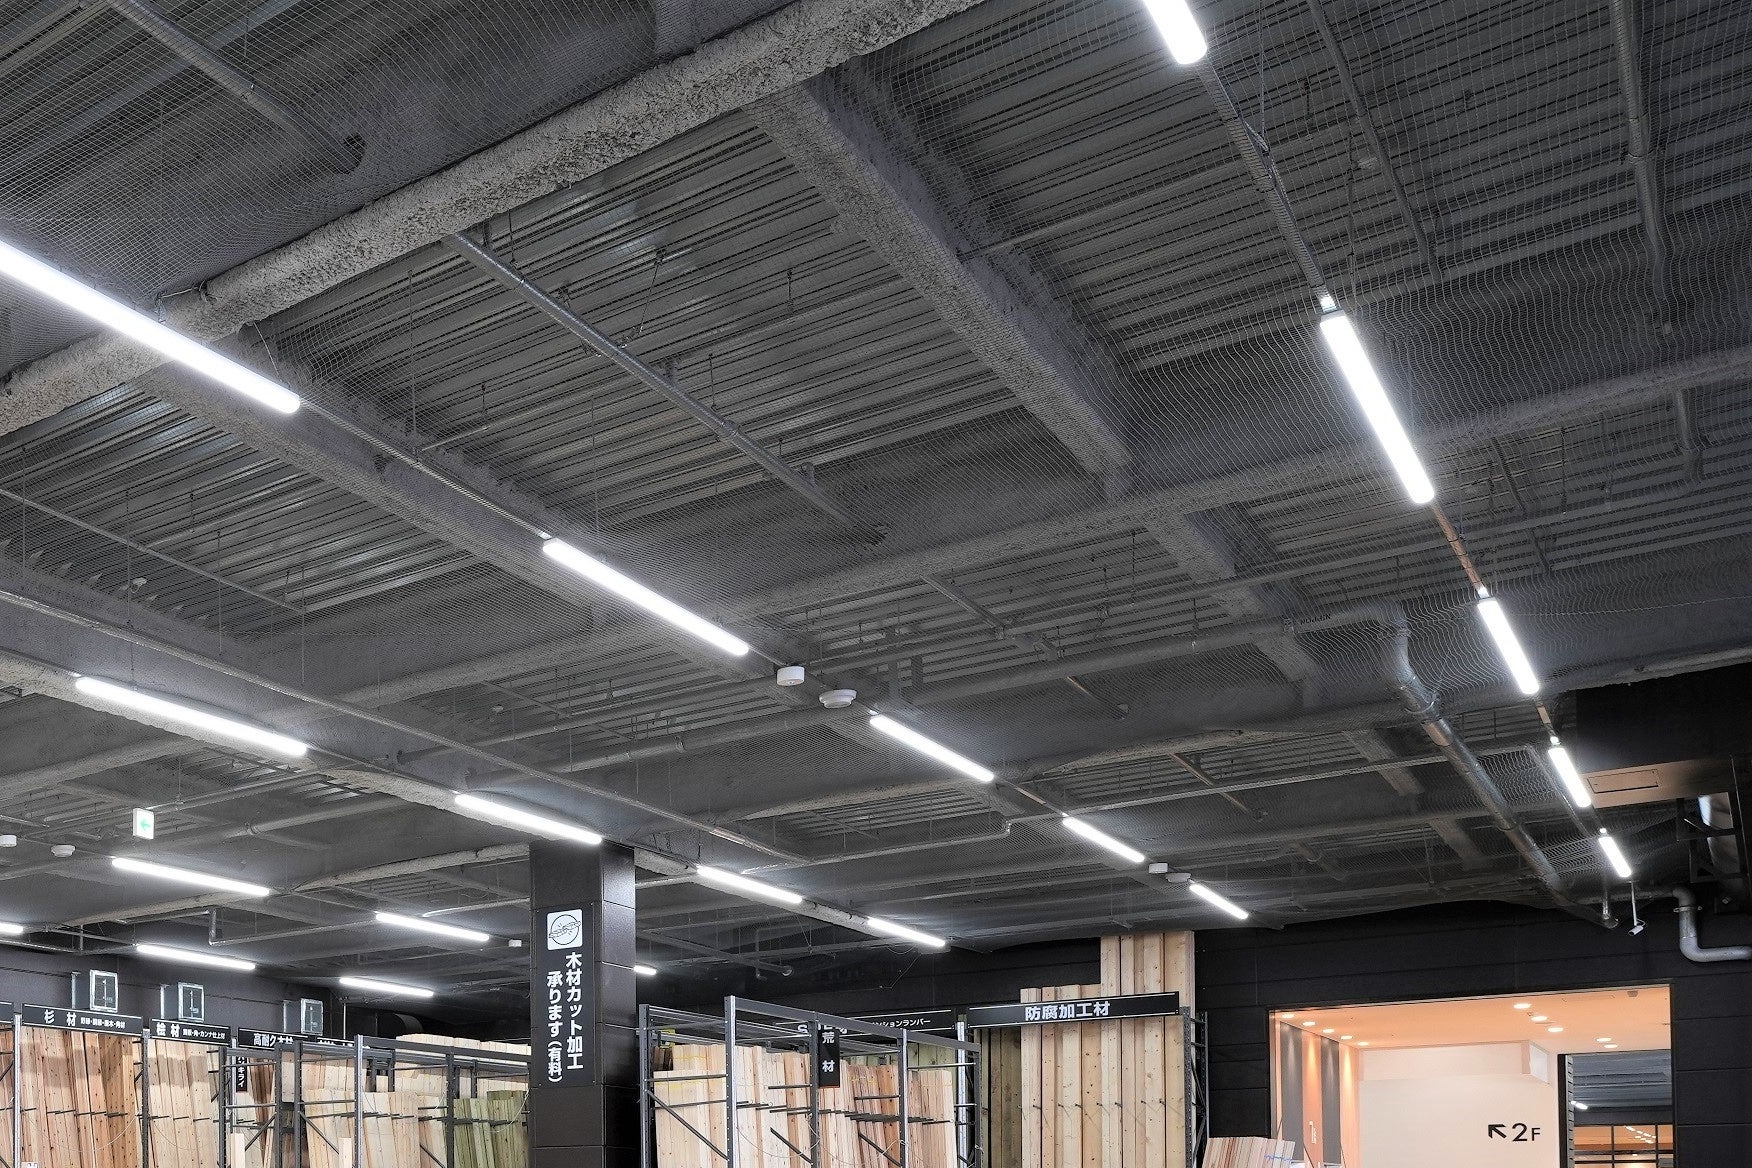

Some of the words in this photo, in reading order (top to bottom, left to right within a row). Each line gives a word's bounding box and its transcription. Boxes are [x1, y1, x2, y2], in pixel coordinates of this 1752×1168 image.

[547, 970, 564, 1083] 承ります(有料)
[566, 951, 584, 1070] 木材カット加工
[1024, 1000, 1111, 1022] 防腐加工材
[821, 1031, 835, 1073] 荒材
[1512, 1122, 1541, 1141] 2F
